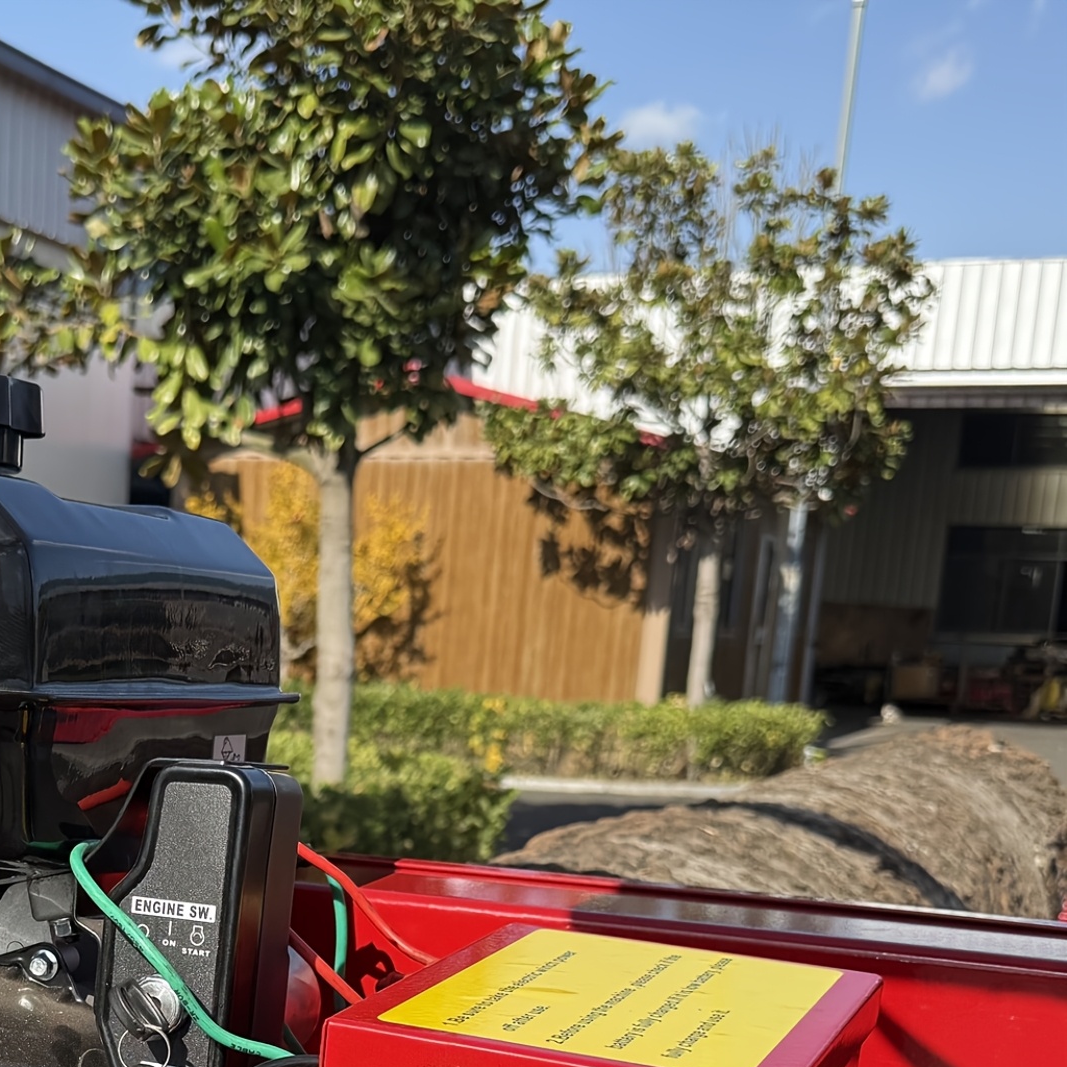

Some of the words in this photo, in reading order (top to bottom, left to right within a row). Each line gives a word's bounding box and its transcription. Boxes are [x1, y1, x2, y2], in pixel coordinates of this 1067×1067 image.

[135, 899, 184, 916] ENGINE
[189, 905, 213, 920] SW.
[162, 939, 176, 947] ON
[181, 947, 211, 957] START
